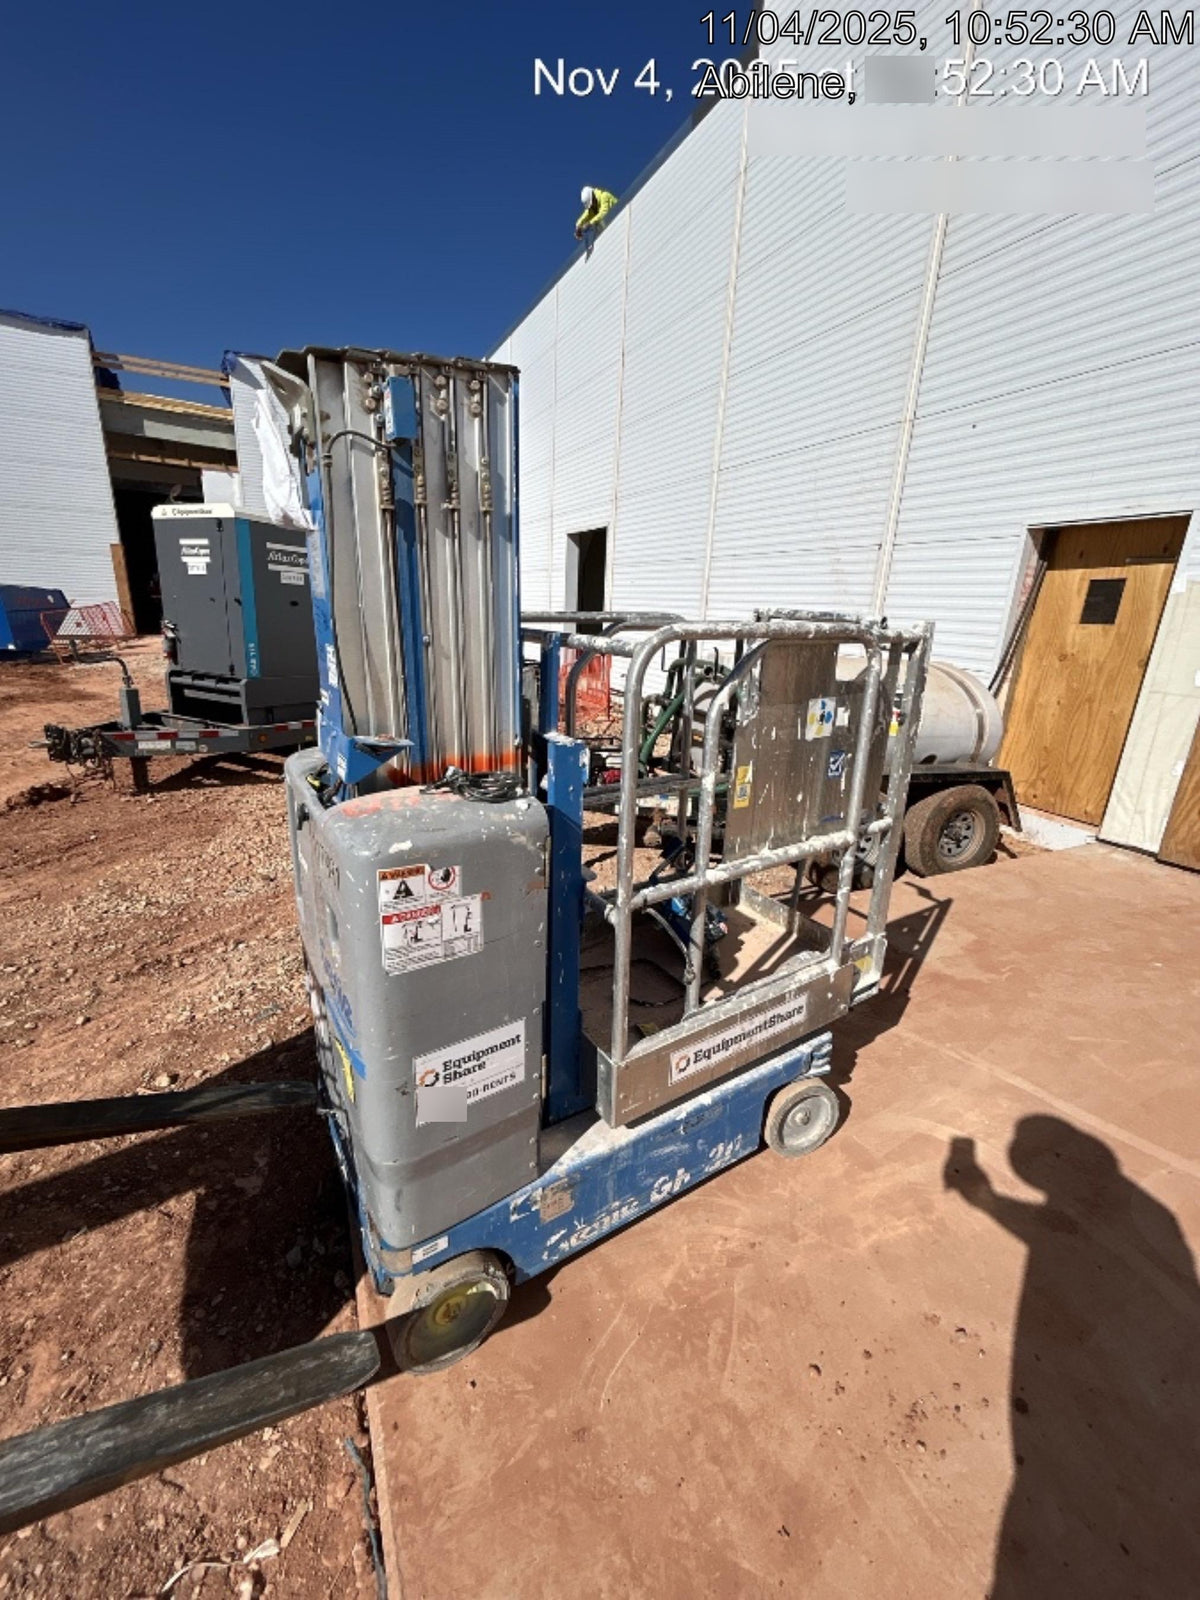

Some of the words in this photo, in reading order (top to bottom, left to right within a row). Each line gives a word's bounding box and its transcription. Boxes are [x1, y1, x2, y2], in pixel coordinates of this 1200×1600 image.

[442, 1034, 522, 1073] Equipment
[693, 1005, 804, 1064] EquipmentShare
[443, 1061, 487, 1085] Share
